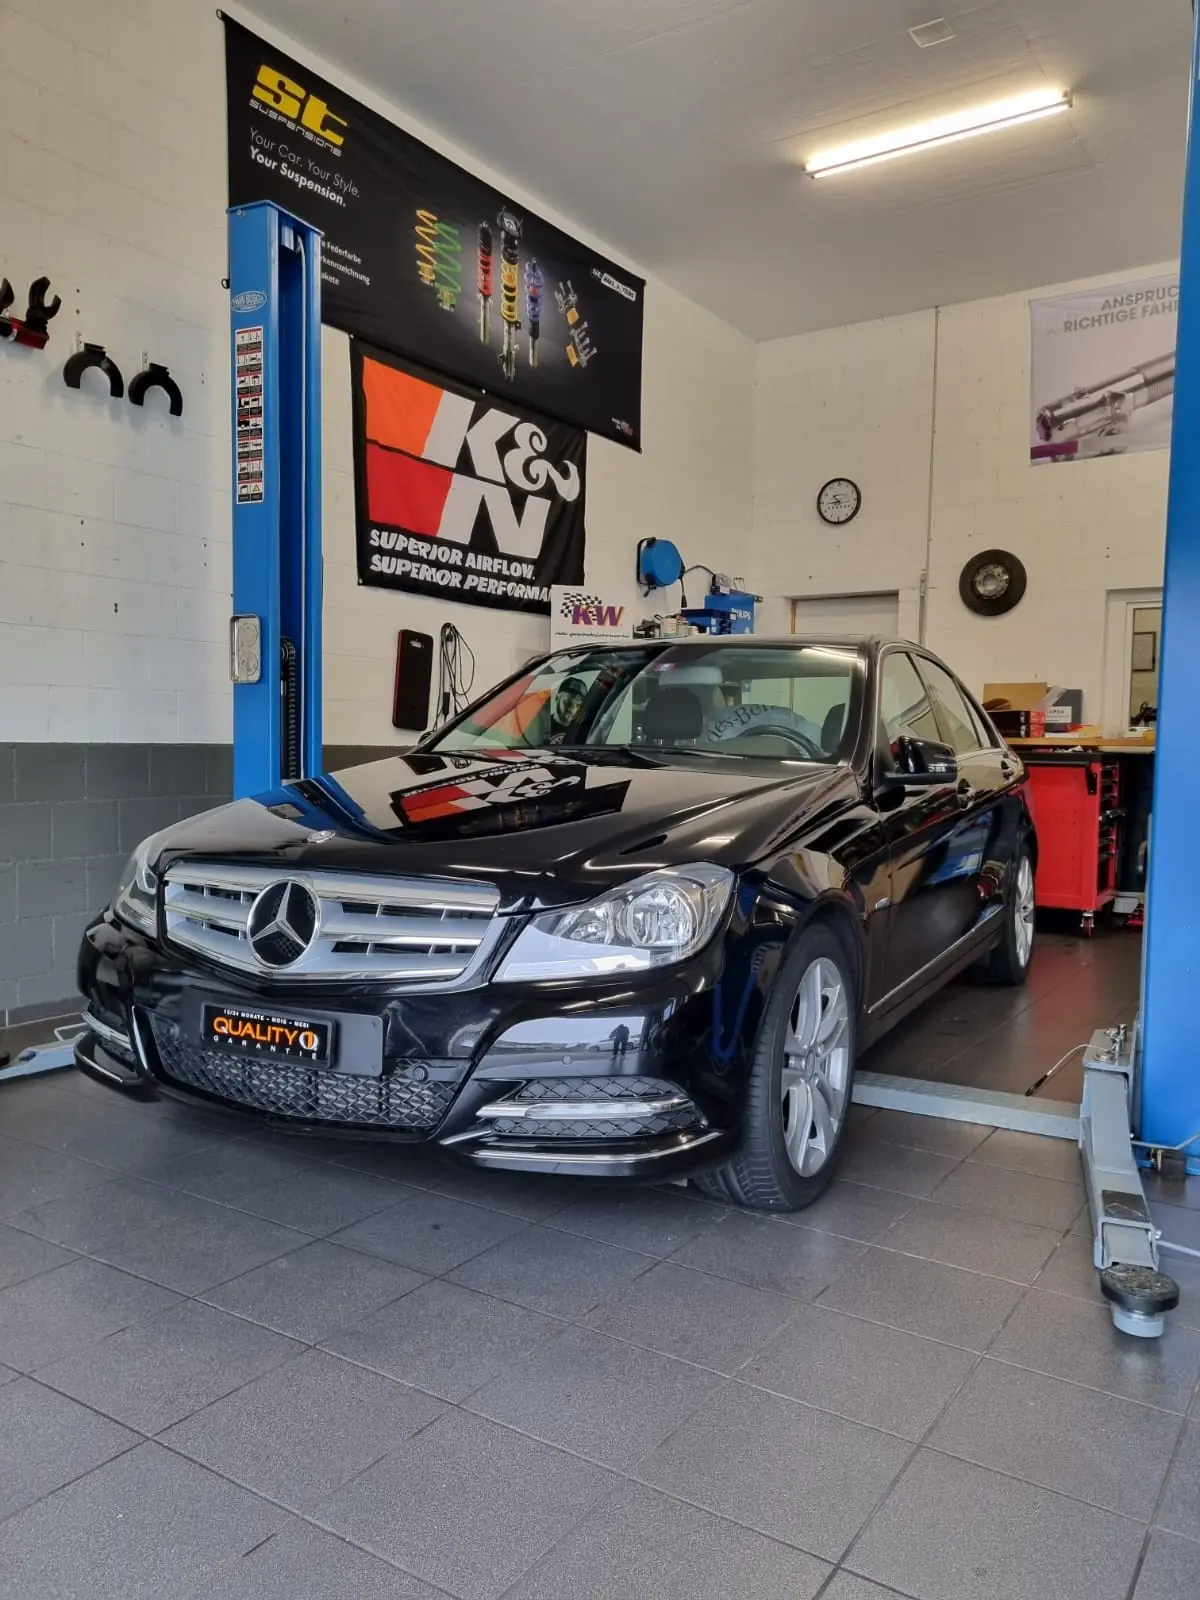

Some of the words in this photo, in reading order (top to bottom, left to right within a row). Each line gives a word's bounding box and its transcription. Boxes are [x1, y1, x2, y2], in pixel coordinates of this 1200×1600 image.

[250, 128, 275, 151] Your
[278, 144, 303, 168] Car.
[307, 159, 331, 181] Your
[333, 173, 360, 198] Style.
[250, 145, 278, 170] Your
[280, 162, 346, 207] Suspension.
[1101, 286, 1178, 311] ANSPRUC
[1063, 307, 1137, 333] RICHTIGE
[369, 529, 463, 566] SUPERIOR
[370, 554, 462, 588] SUPERIOR
[463, 575, 551, 602] PERFORMA
[571, 604, 625, 627] KW
[241, 1012, 264, 1021] MONATE
[213, 1017, 298, 1046] QUALITY
[213, 1035, 317, 1060] GARANTIE
